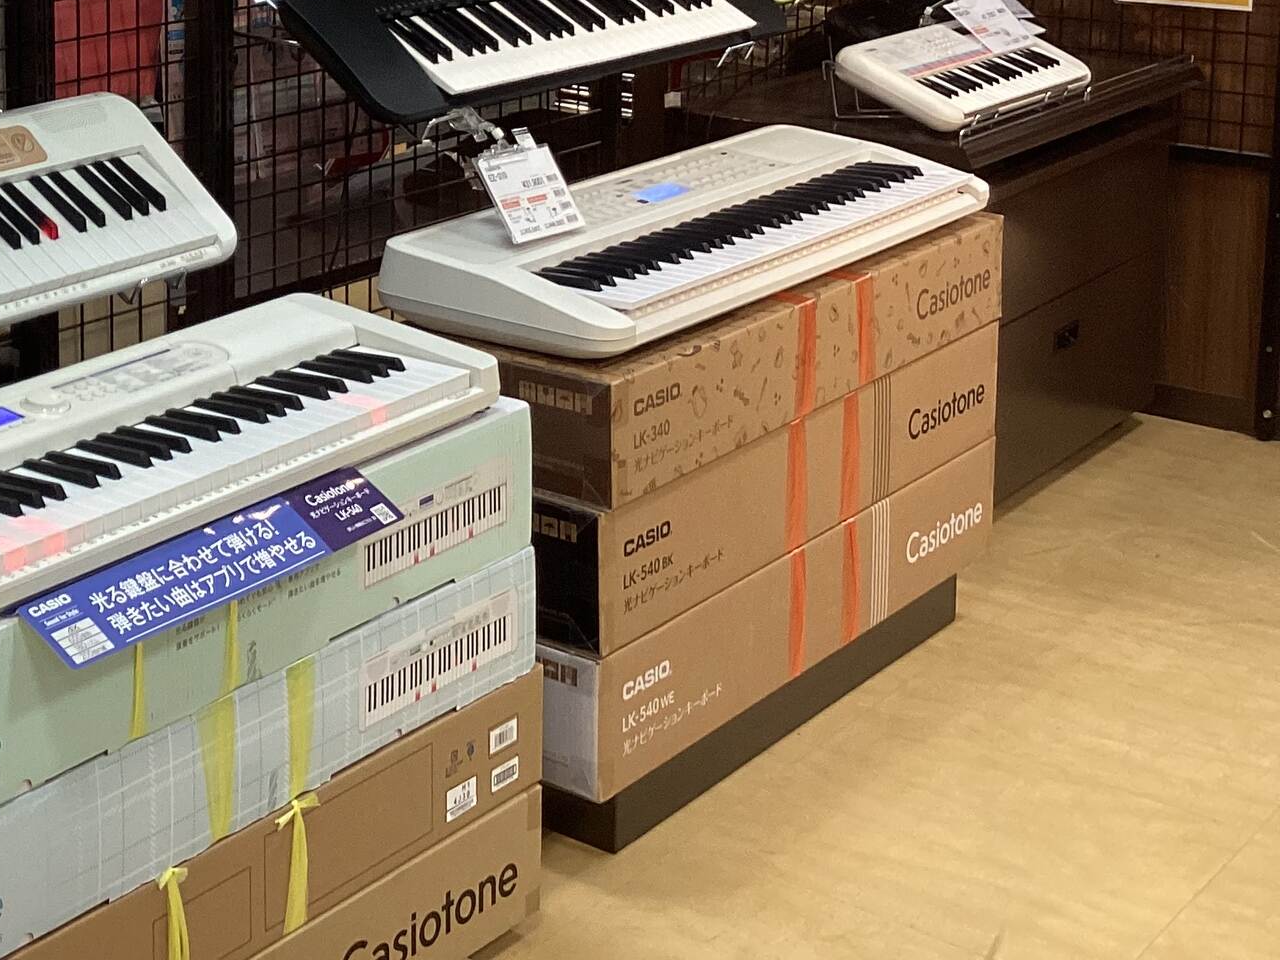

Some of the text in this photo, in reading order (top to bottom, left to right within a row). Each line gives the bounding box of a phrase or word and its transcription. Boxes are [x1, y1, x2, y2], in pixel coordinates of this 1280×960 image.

[633, 268, 991, 417] CASIO Casiotone
[623, 383, 985, 558] CASIO Casiotone
[633, 418, 670, 450] LK-340
[633, 414, 734, 473] 光ナビゲーションキーボード
[28, 593, 72, 618] CASIO
[88, 519, 280, 613] 光る鍵盤に合わせて弾ける!
[106, 530, 317, 635] 弾きたい曲はアプリで増やせる
[622, 501, 983, 701] CASIO Casiotone
[623, 548, 724, 614] 光ナビゲーションキーボード
[622, 681, 723, 758] 光ナビゲーションキーボード
